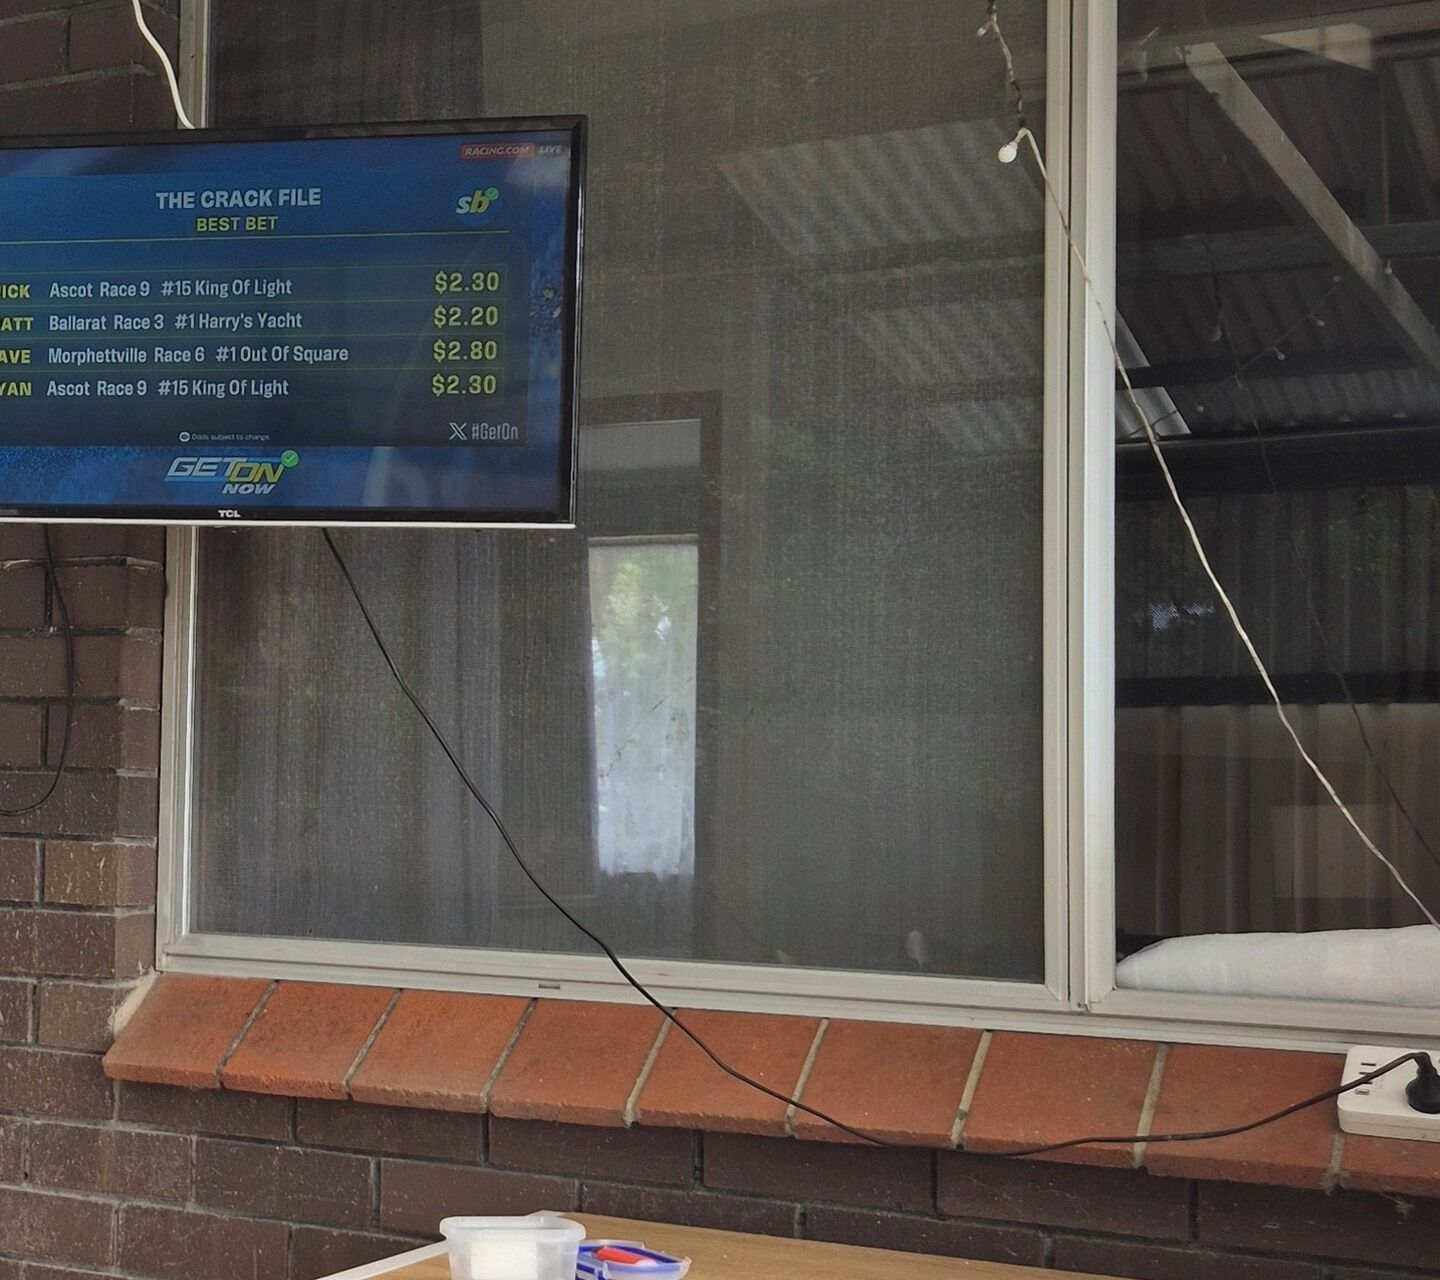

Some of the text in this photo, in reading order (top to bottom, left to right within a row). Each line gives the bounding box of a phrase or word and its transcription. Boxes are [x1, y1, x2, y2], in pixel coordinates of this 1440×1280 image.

[540, 145, 563, 154] LIVE
[156, 188, 321, 209] THE CRACK FILE
[196, 216, 278, 232] BEST BET
[49, 282, 93, 298] Ascot
[100, 281, 137, 297] Race
[140, 281, 150, 296] 9
[161, 280, 191, 296] #15
[195, 280, 228, 298] King
[232, 279, 251, 295] Of
[254, 279, 292, 297] Light
[435, 271, 500, 295] $2.30
[49, 315, 107, 331] Ballarat
[114, 314, 150, 330] Race
[154, 314, 165, 330] 3
[175, 313, 195, 329] #1
[199, 313, 253, 331] Harry's
[257, 312, 303, 328] Yacht
[434, 305, 499, 328] $2.20
[48, 347, 147, 366] Morphettville
[154, 347, 191, 362] Race
[194, 347, 205, 362] 6
[216, 346, 236, 362] #1
[240, 346, 267, 361] Out
[271, 346, 290, 361] Of
[293, 346, 349, 364] Square
[433, 339, 498, 363] $2.80
[47, 380, 90, 396] Ascot
[97, 380, 134, 396] Race
[136, 380, 148, 396] 9
[158, 380, 189, 396] #15
[192, 380, 225, 398] King
[229, 380, 247, 395] Of
[251, 380, 289, 398] Light
[432, 373, 497, 397] $2.30
[471, 422, 518, 440] #GetOn
[221, 483, 276, 495] NOW
[218, 510, 241, 518] TCL
